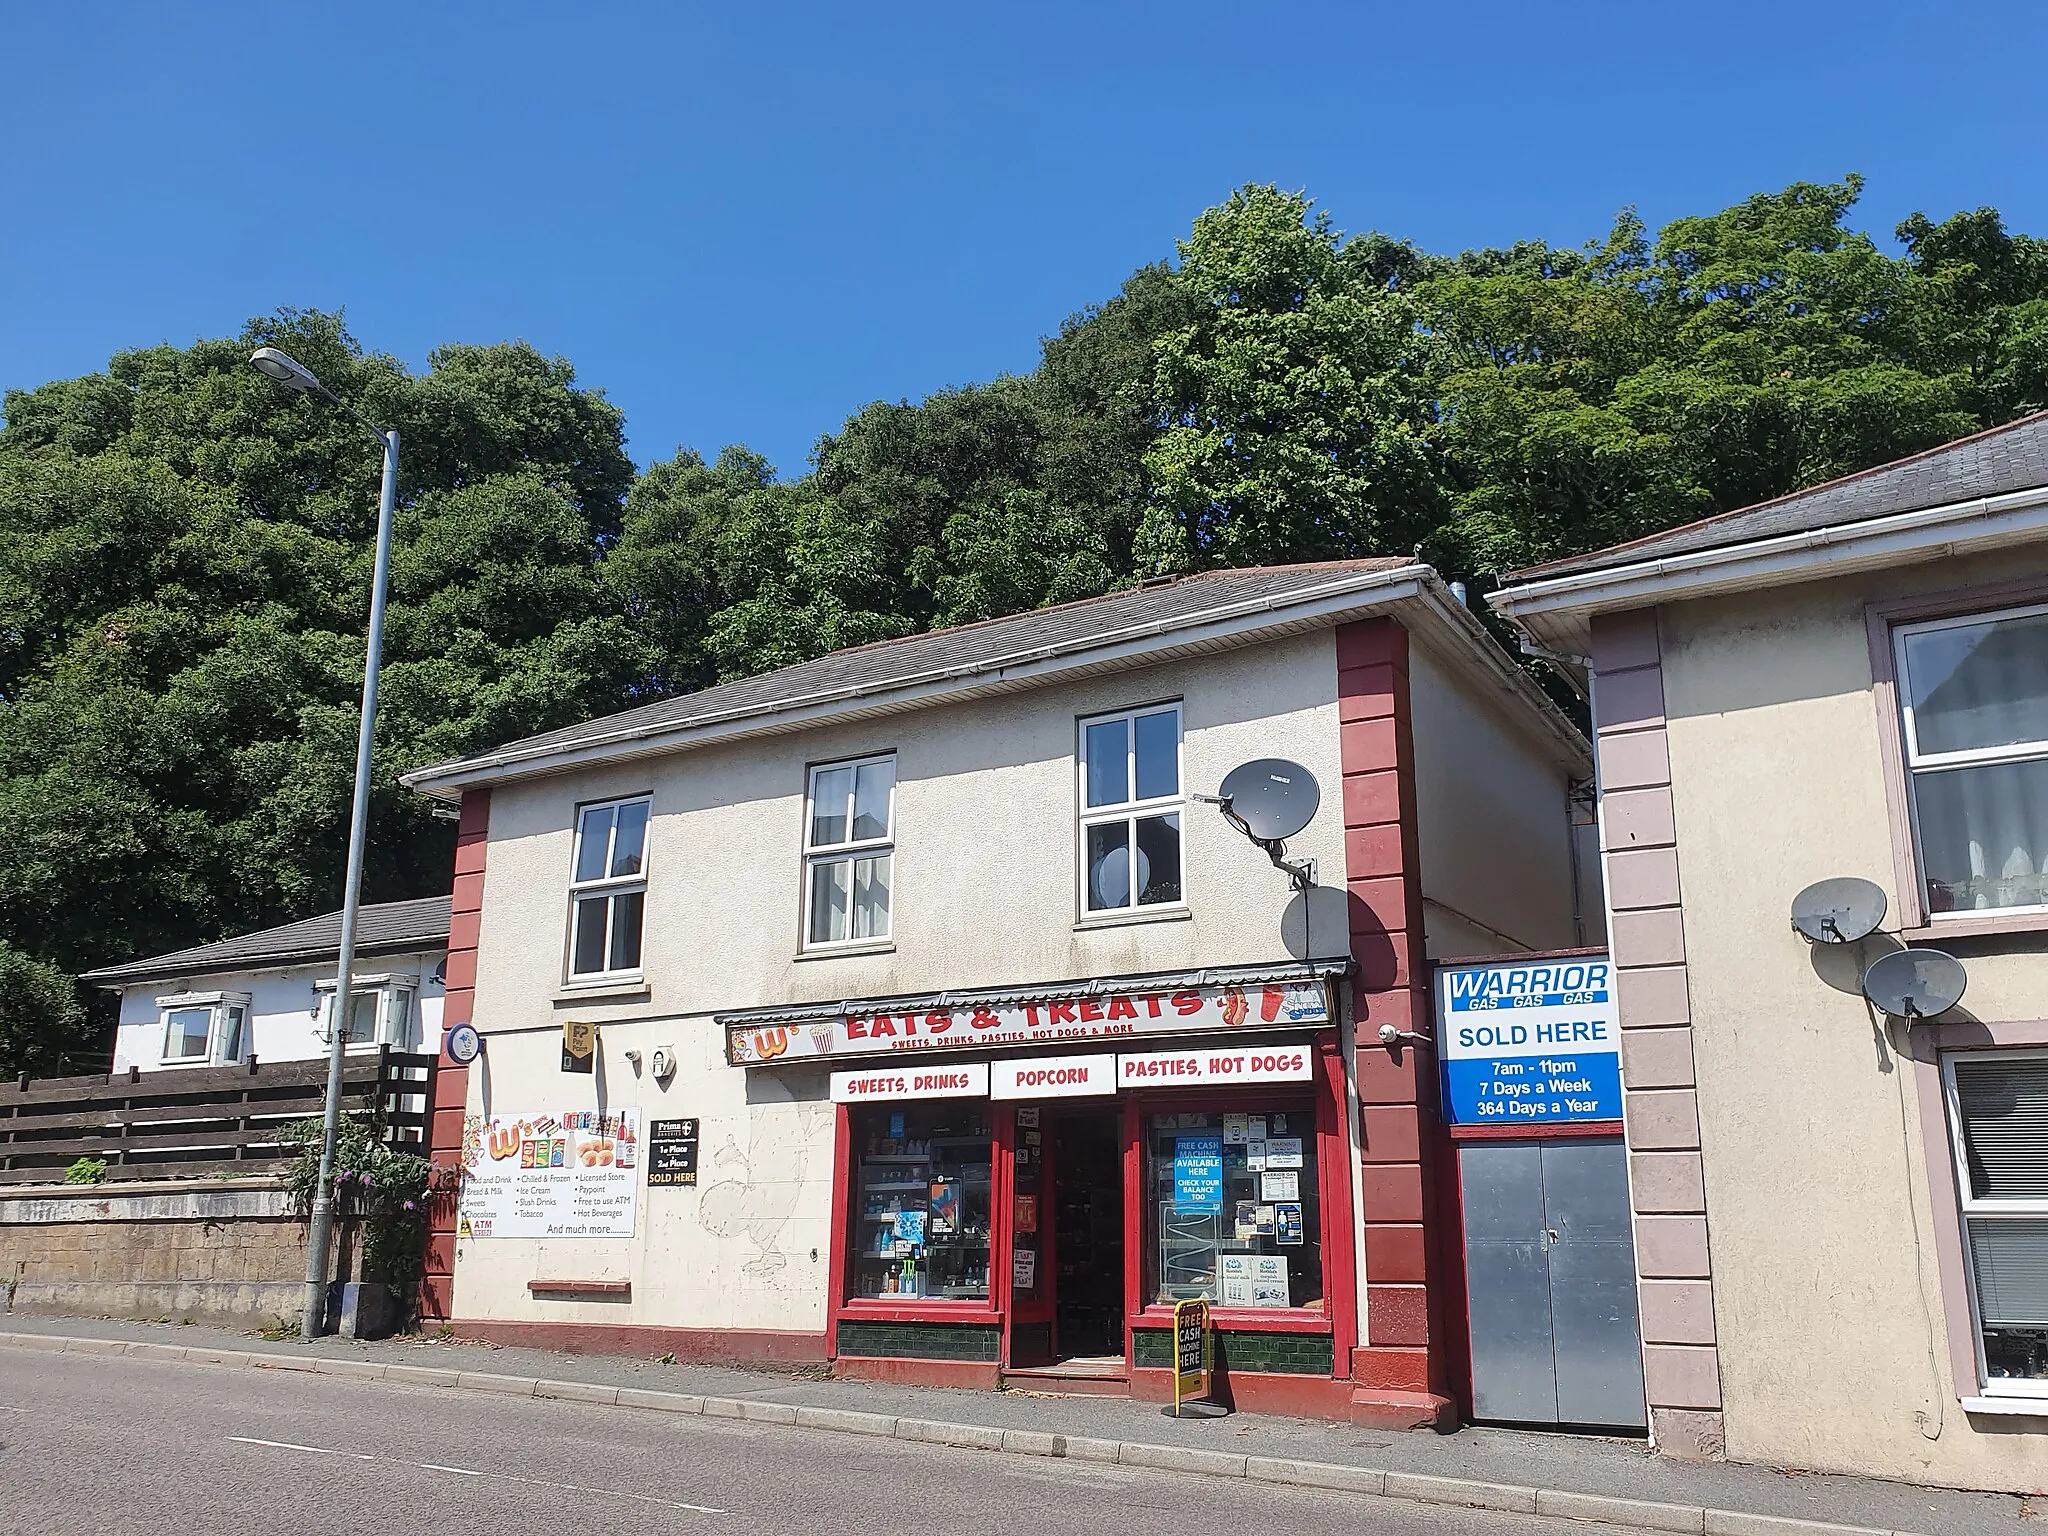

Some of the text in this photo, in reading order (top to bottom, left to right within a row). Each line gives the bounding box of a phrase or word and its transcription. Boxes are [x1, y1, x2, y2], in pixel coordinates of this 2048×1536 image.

[1450, 965, 1608, 998] WARRIOR
[1469, 992, 1594, 1010] GAS GAS GAS
[846, 988, 1204, 1040] EATS & TREATS
[892, 1024, 1134, 1049] SWEETS, DRINKS, PASTIES, HOT DOGS & MORE
[1459, 1021, 1608, 1047] SOLD HERE
[1125, 1055, 1304, 1077] PASTIES, HOT DOGS
[1492, 1062, 1524, 1075] 7am
[1539, 1060, 1576, 1077] 11pm
[1016, 1067, 1089, 1087] POPCORN
[847, 1073, 969, 1095] SWEETS, DRINKS
[1480, 1078, 1592, 1097] 7 Days a Week
[1477, 1098, 1599, 1117] 364 Days a Year
[658, 1122, 681, 1131] Prima
[669, 1144, 688, 1153] Place
[1177, 1141, 1219, 1150] FREE CASH
[1180, 1150, 1217, 1158] MACHINE
[669, 1158, 688, 1168] Place
[1177, 1159, 1219, 1167] AVAILABLE
[1188, 1167, 1208, 1175] HERE
[495, 1175, 512, 1184] Drink
[521, 1174, 570, 1183] Chilled & Frozen
[580, 1172, 625, 1181] Licensed Store
[649, 1172, 696, 1183] SOLD HERE
[466, 1187, 503, 1195] Bread & Milk
[530, 1186, 550, 1194] Cream
[579, 1185, 605, 1195] Paypoint
[466, 1199, 486, 1207] Sweets
[519, 1198, 556, 1206] Slush Drinks
[578, 1197, 592, 1205] Free
[594, 1197, 601, 1205] to
[614, 1196, 631, 1204] ATM
[465, 1210, 497, 1218] Chocolates
[519, 1209, 544, 1218] Tobacco
[577, 1208, 623, 1219] Hot Beverages
[474, 1220, 492, 1228] ATM
[546, 1223, 563, 1234] And
[565, 1223, 587, 1234] much
[1179, 1313, 1201, 1328] FREE
[1179, 1327, 1201, 1343] CASH
[1179, 1351, 1200, 1368] HERE
